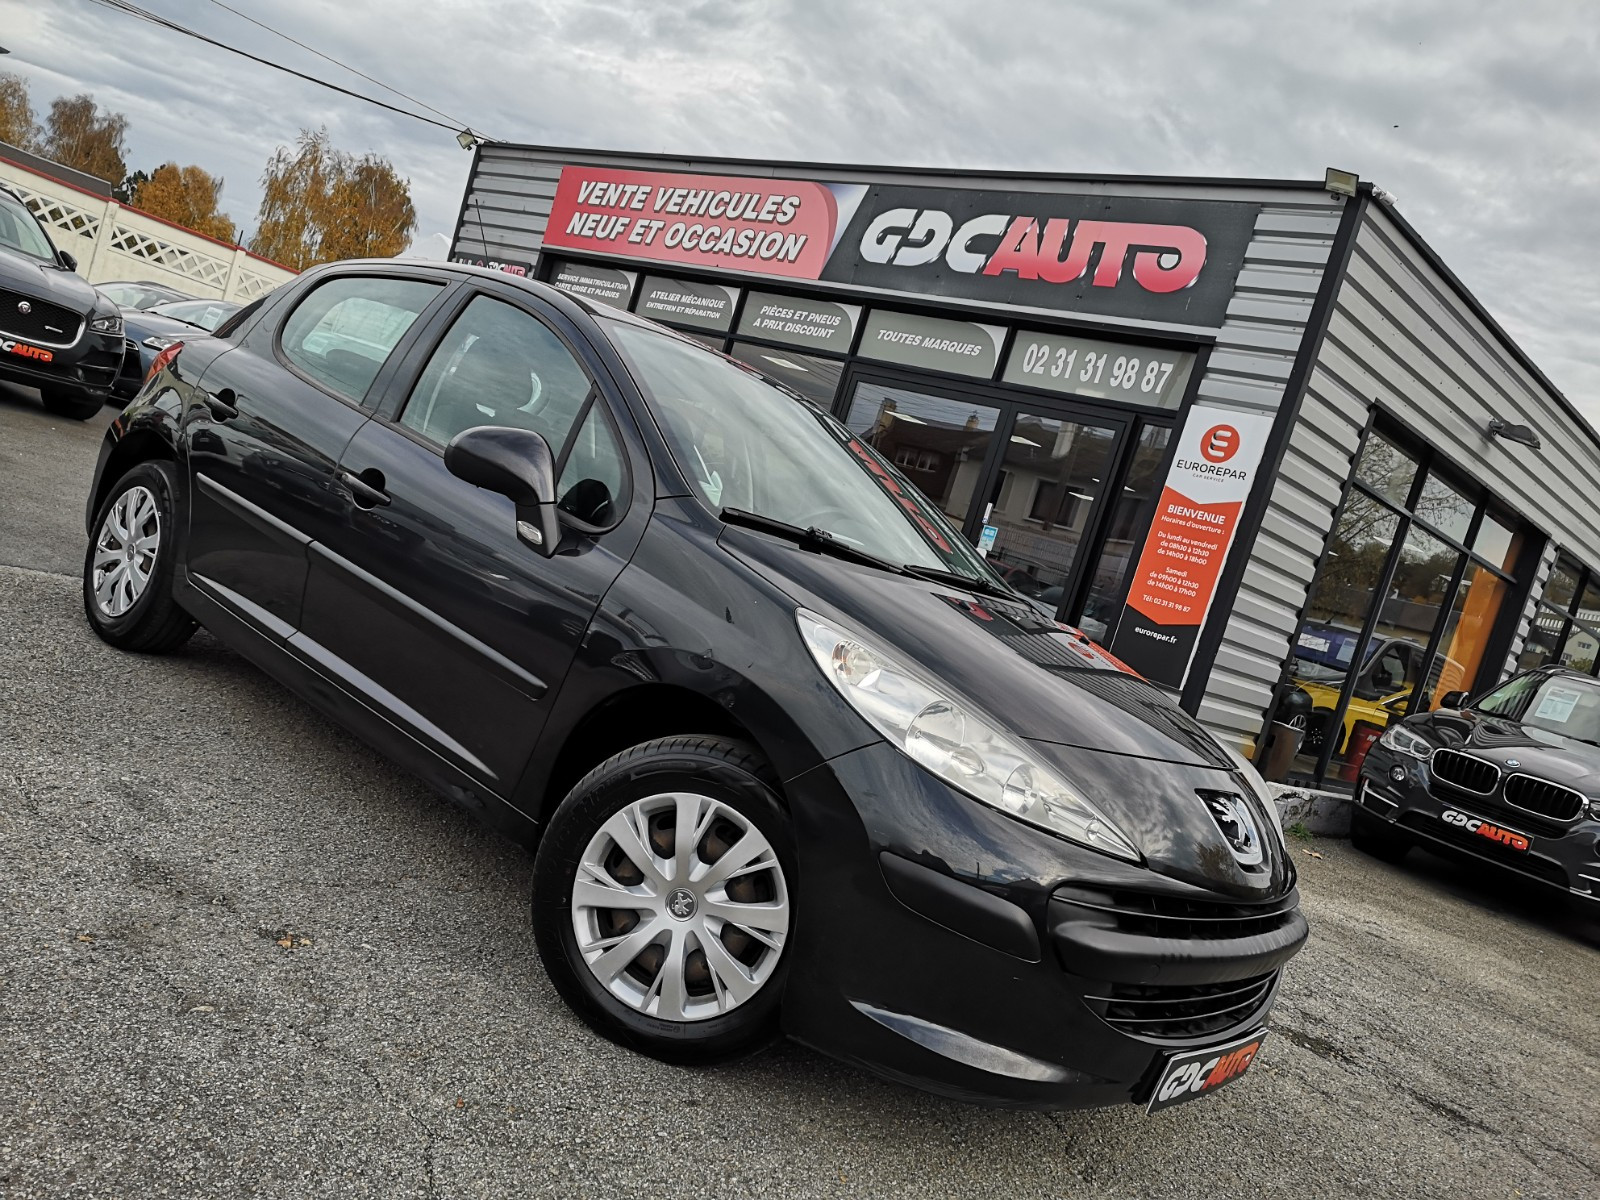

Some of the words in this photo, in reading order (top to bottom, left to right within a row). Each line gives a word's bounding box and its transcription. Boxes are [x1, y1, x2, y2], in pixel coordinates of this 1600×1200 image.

[577, 181, 652, 210] VENTE
[653, 187, 801, 224] VEHICULES
[566, 212, 630, 240] NEUF
[628, 219, 664, 245] ET
[664, 223, 808, 263] OCCASION
[555, 282, 572, 290] CARTE
[572, 285, 587, 293] GRISE
[594, 288, 620, 299] PLAQUES
[557, 273, 580, 282] SERVICE
[579, 276, 628, 290] IMMATRICULATION
[650, 290, 681, 302] ATELIER
[680, 294, 726, 309] MÉCANIQUE
[646, 301, 677, 311] ENTRETIEN
[683, 306, 721, 319] RÉPARATION
[760, 304, 795, 320] PIÈCES
[793, 311, 808, 321] ET
[807, 312, 842, 326] PNEUS
[753, 318, 761, 327] A
[761, 321, 786, 331] PRIX
[786, 323, 835, 339] DISCOUNT
[877, 329, 922, 349] TOUTES
[921, 337, 982, 357] MARQUES
[1023, 343, 1050, 374] 02
[1051, 347, 1078, 379] 31
[1079, 351, 1109, 384] 31
[1109, 355, 1140, 389] 98
[1141, 360, 1174, 395] 87
[1176, 459, 1247, 480] EUROREPAR
[1167, 504, 1226, 525] BIENVENUE
[1161, 515, 1186, 526] Horaires
[1186, 521, 1222, 534] d'ouverture
[1167, 533, 1182, 541] lundi
[1191, 539, 1218, 550] vendredi
[1166, 549, 1184, 559] 14h00
[1184, 552, 1188, 560] à
[1189, 554, 1207, 565] 18h00
[1192, 548, 1209, 556] 12h30
[1166, 567, 1187, 577] Samedi
[1155, 581, 1173, 590] 14h00
[1178, 588, 1196, 597] 17h00
[1182, 580, 1199, 589] 12h30
[1135, 627, 1177, 644] eurorepar.fr
